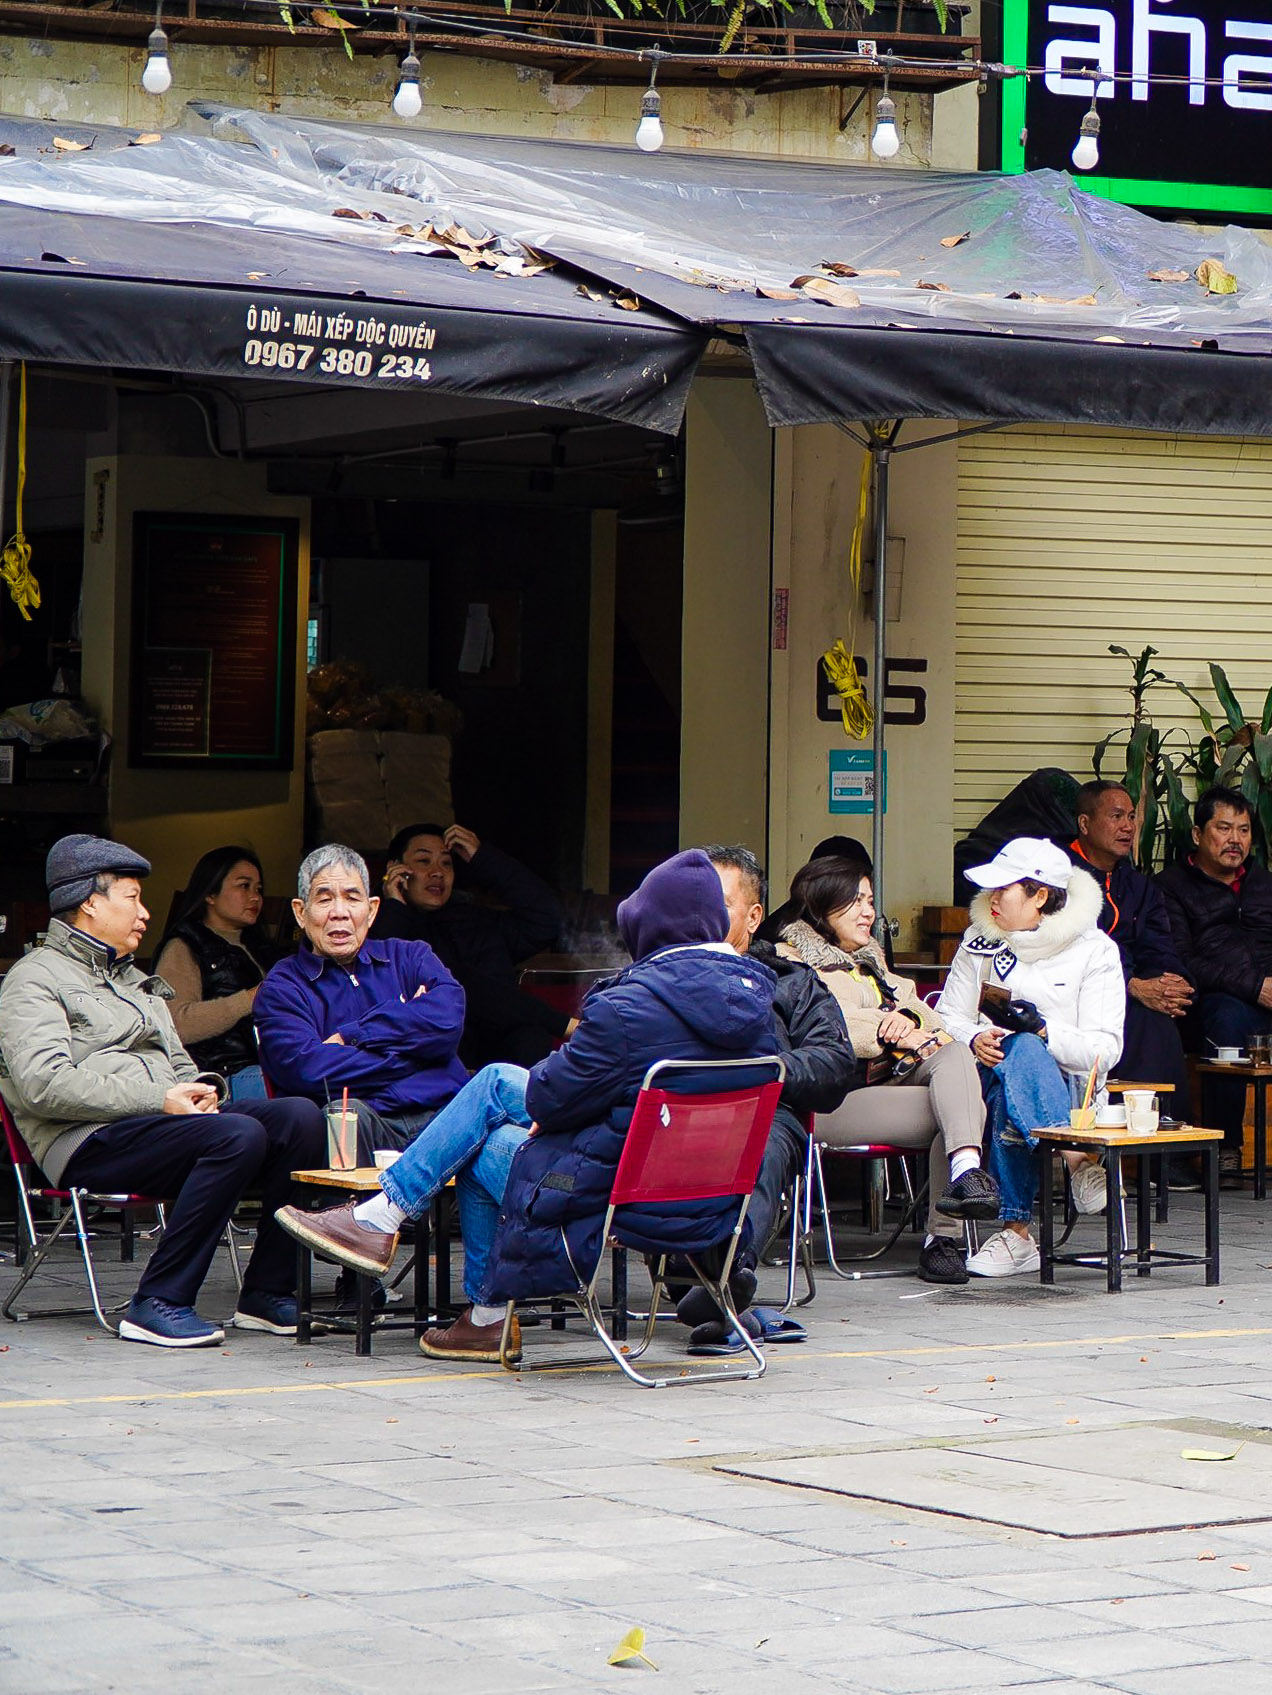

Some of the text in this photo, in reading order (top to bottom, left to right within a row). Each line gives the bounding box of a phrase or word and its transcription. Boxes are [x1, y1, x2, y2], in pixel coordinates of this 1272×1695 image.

[247, 304, 257, 331] Ô
[260, 306, 281, 333] DÙ
[293, 310, 322, 338] MÁI
[324, 312, 354, 341] XẾP
[355, 317, 386, 348] ĐỘC
[388, 321, 436, 350] QUYỀN
[244, 339, 432, 380] 0967 380 234
